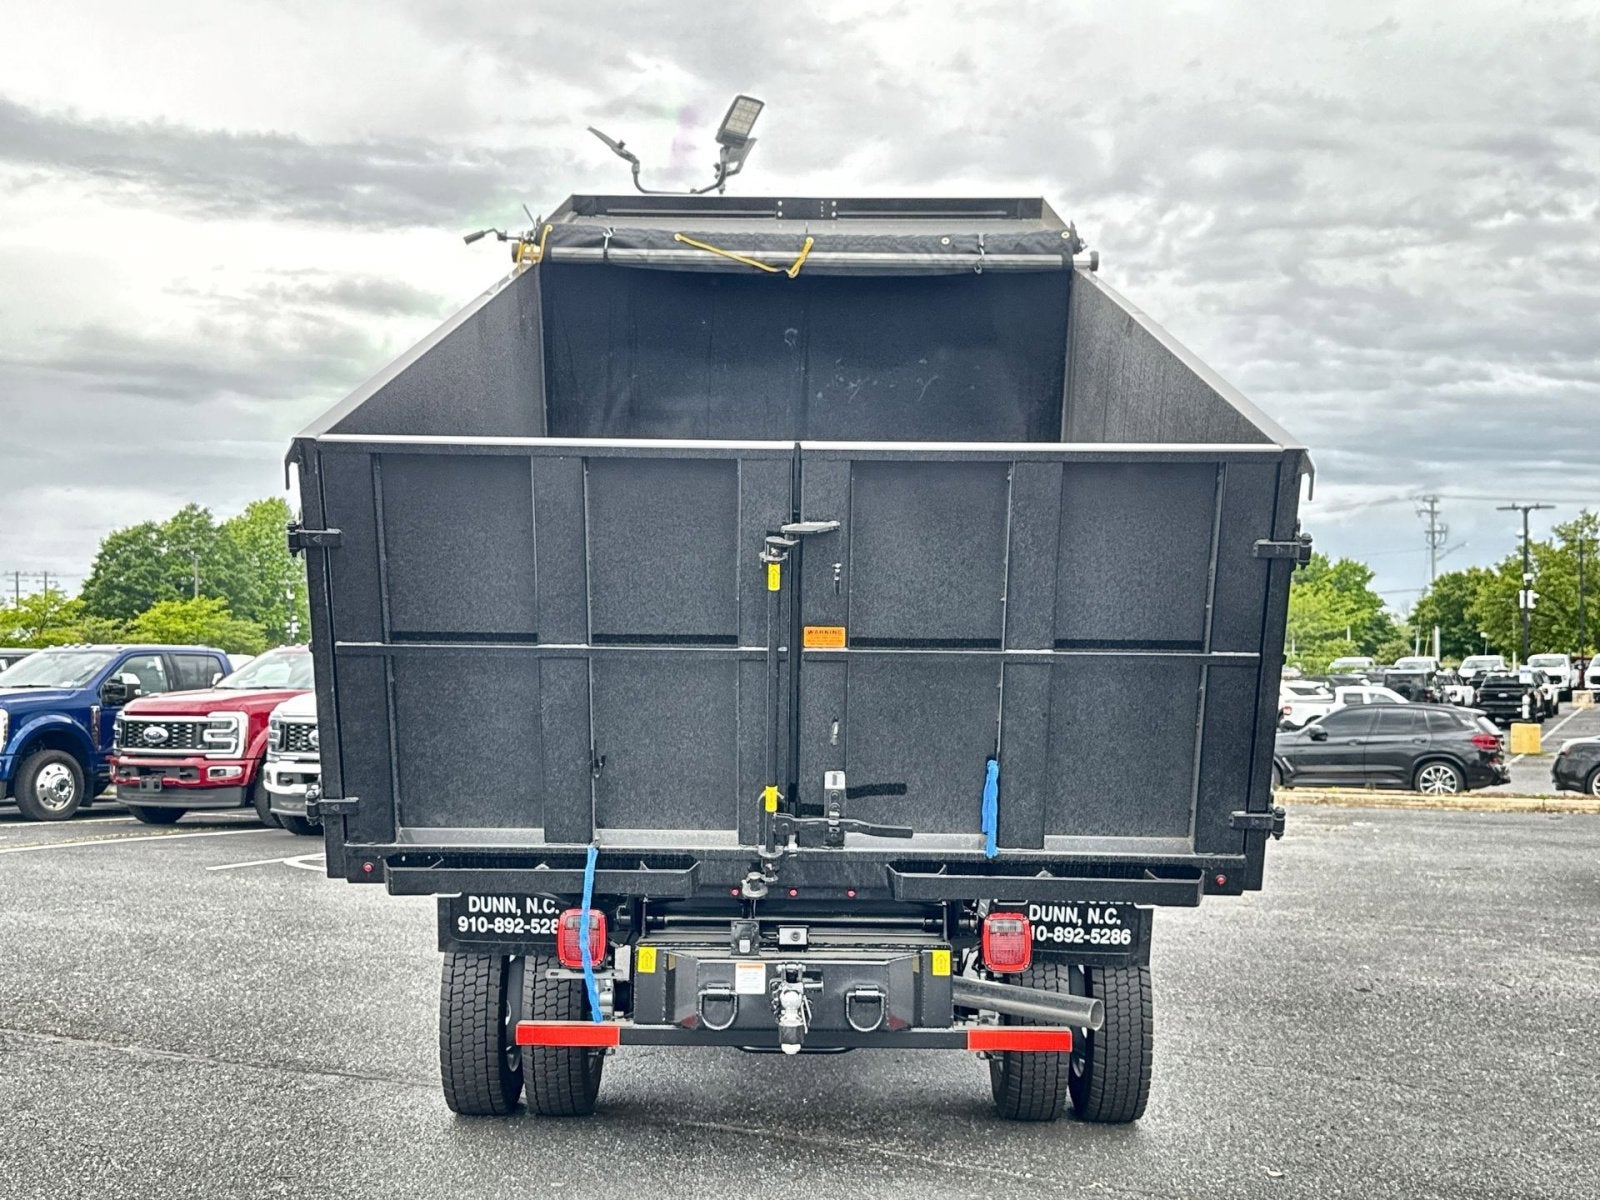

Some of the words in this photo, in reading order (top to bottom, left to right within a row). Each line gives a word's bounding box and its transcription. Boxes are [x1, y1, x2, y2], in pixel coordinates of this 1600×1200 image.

[468, 895, 521, 916] DUNN,
[525, 897, 560, 914] N.C.
[1029, 904, 1082, 926] DUNN,
[1087, 907, 1122, 925] N.C.
[457, 916, 559, 935] 910-892-528
[1031, 924, 1132, 945] 10-892-5286
